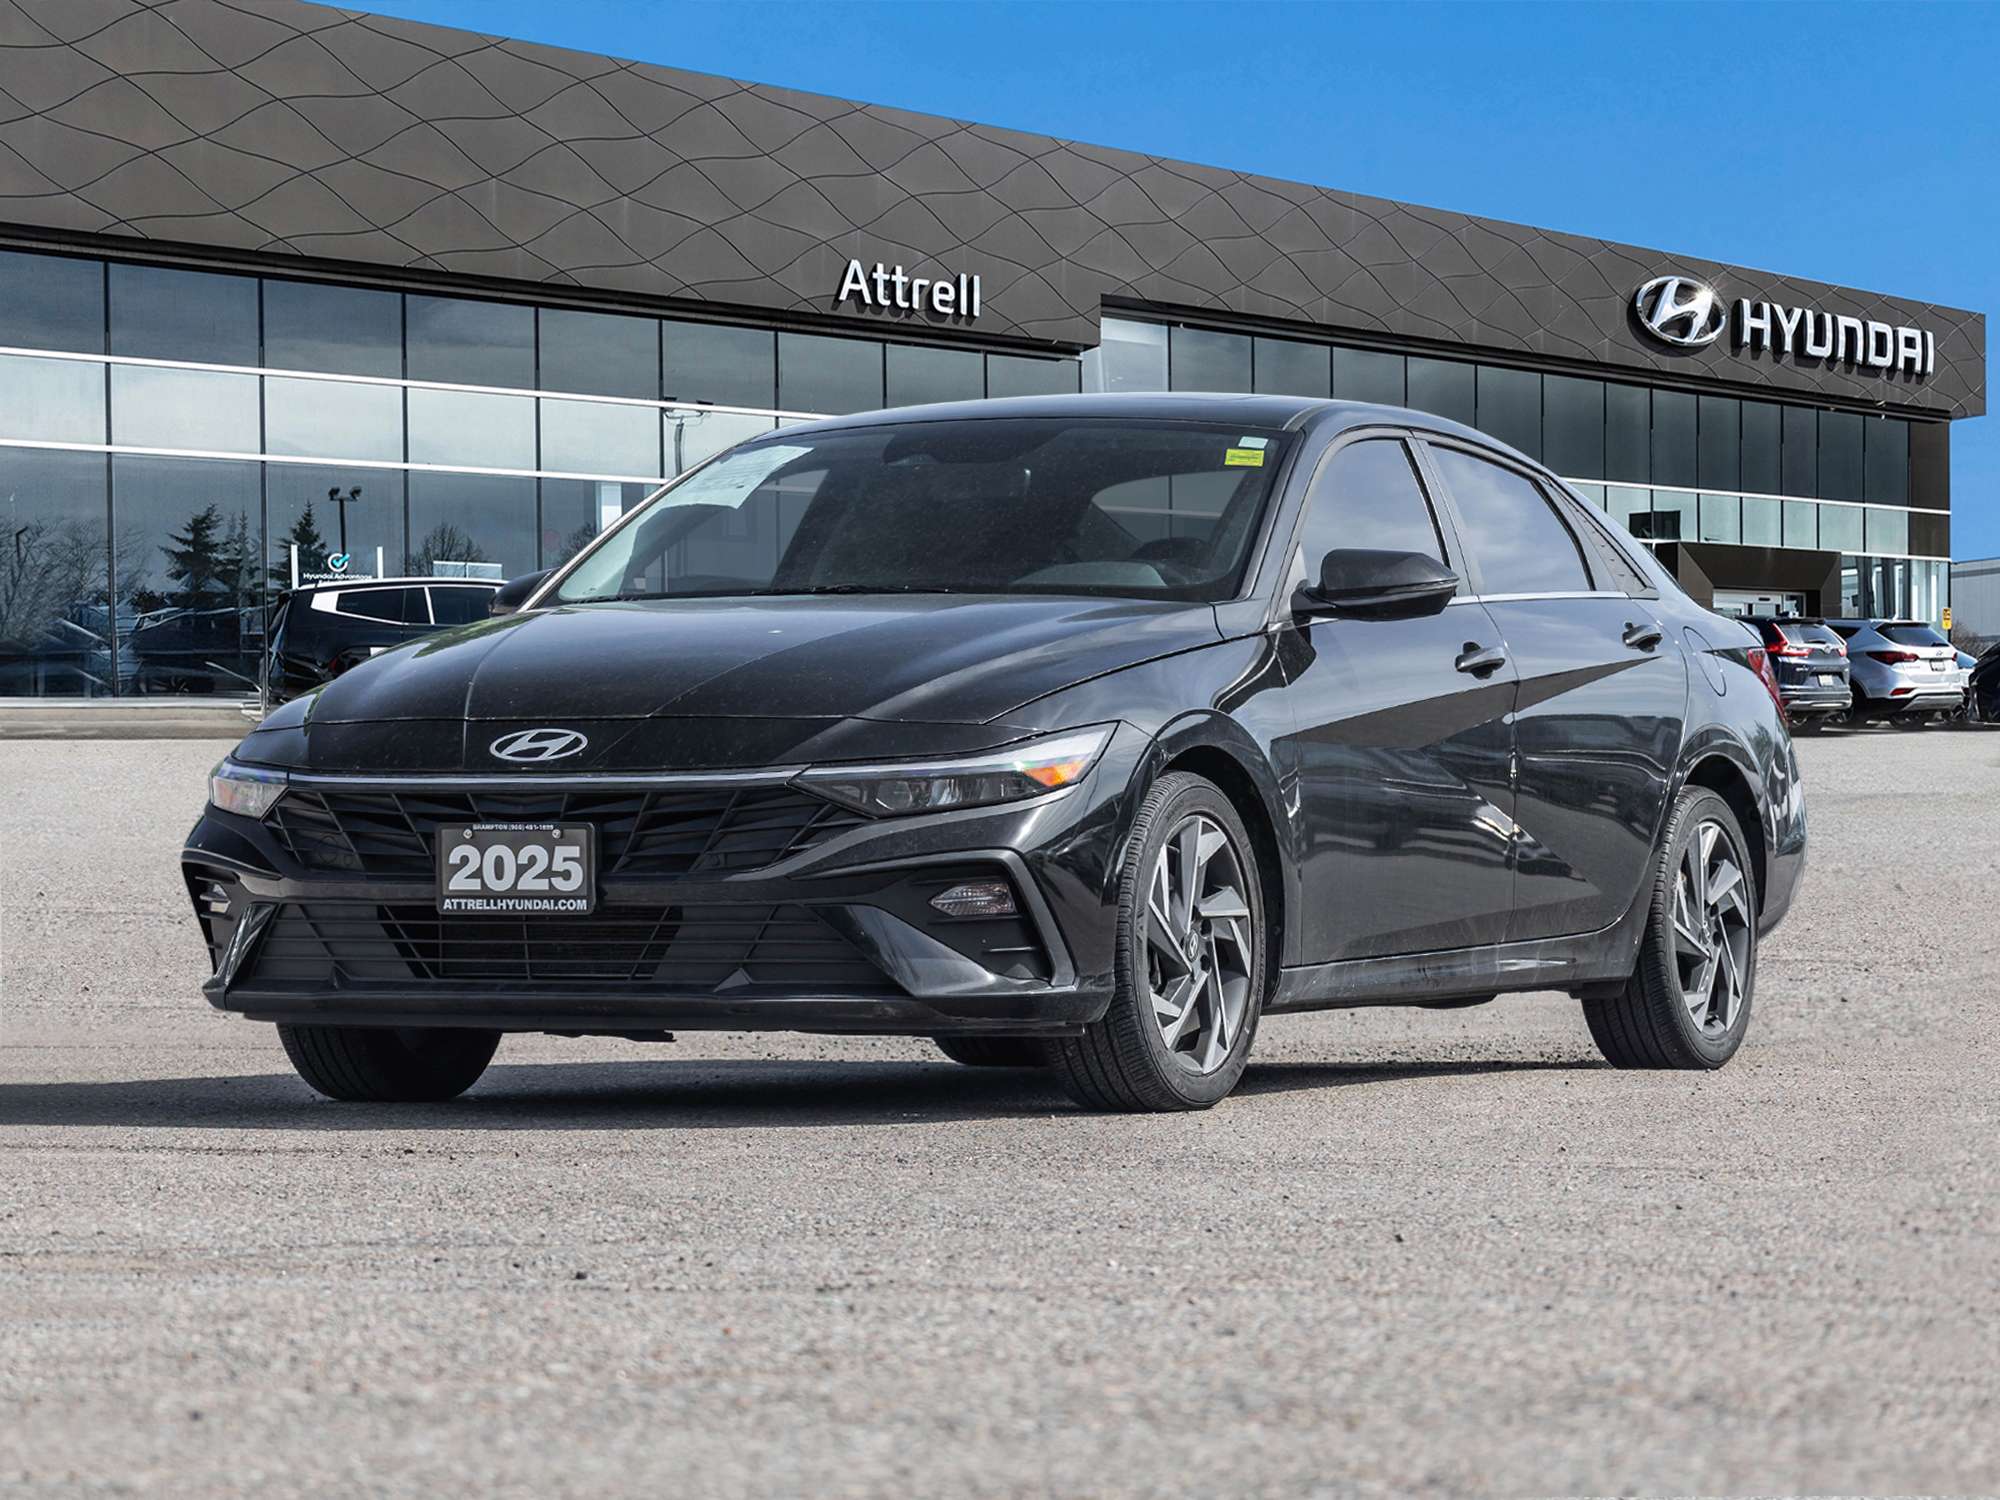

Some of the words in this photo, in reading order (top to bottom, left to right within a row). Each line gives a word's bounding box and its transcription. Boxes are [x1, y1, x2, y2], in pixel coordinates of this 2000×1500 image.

[838, 258, 981, 318] Attrell
[1739, 298, 1935, 377] HYUNDAI
[448, 844, 584, 892] 2025
[442, 898, 588, 911] ATTRELLHYUNDAI.COM
